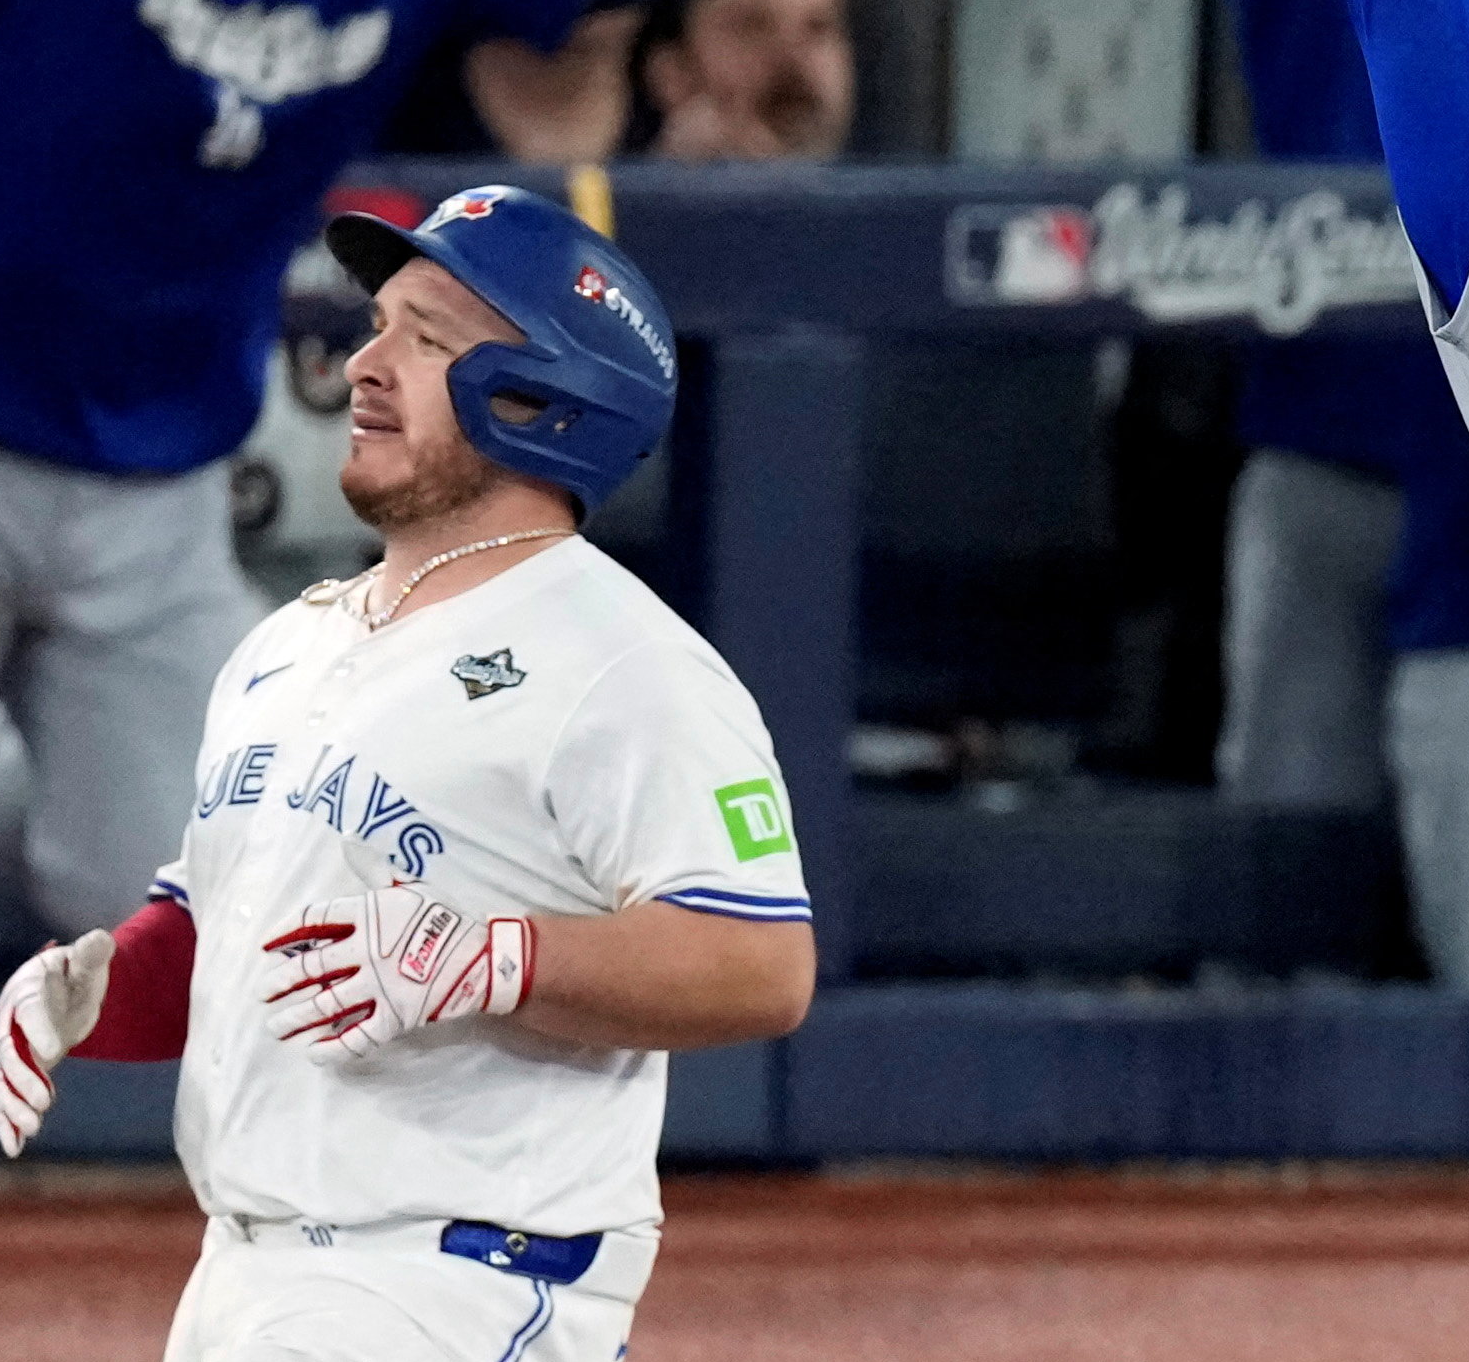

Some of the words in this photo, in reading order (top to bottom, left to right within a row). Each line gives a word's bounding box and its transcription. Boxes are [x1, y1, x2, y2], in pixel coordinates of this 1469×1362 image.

[198, 743, 277, 819] UE
[286, 743, 444, 879] JAYS
[725, 791, 784, 843] TD
